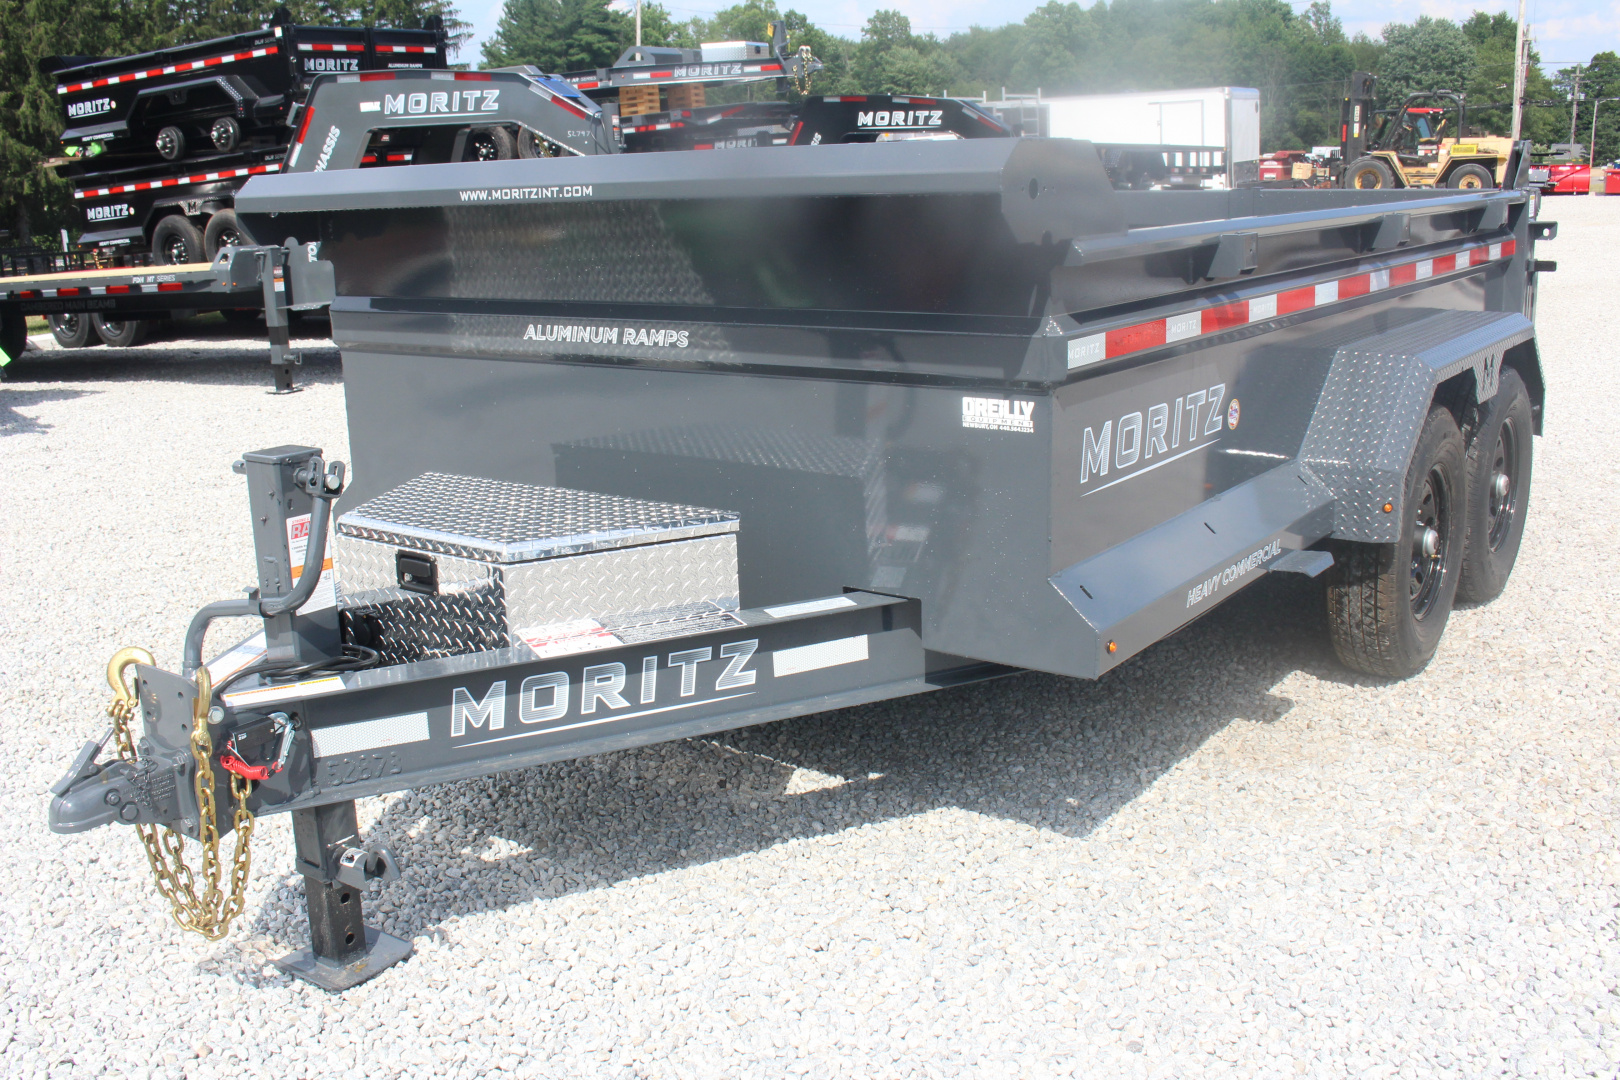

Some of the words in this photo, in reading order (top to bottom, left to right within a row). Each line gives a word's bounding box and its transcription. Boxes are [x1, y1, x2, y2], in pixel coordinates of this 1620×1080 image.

[304, 58, 359, 71] MORITZ
[674, 63, 742, 78] MORITZ
[67, 97, 111, 117] MORITZ
[384, 89, 500, 115] MORITZ
[857, 110, 944, 127] MORITZ
[459, 185, 593, 202] WWW.MORITZINT.COM
[87, 203, 129, 220] MORITZ
[156, 274, 176, 283] SERIES
[1172, 319, 1197, 335] MORITZ
[523, 324, 619, 345] ALUMINUM
[622, 327, 690, 348] RAMPS
[1068, 341, 1100, 359] MORITZ
[962, 415, 1034, 428] EQUIPMENT
[1080, 382, 1226, 484] MORITZ
[1186, 572, 1222, 609] HEAVY
[1222, 538, 1282, 586] COMMERCIAL
[450, 638, 759, 738] MORITZ
